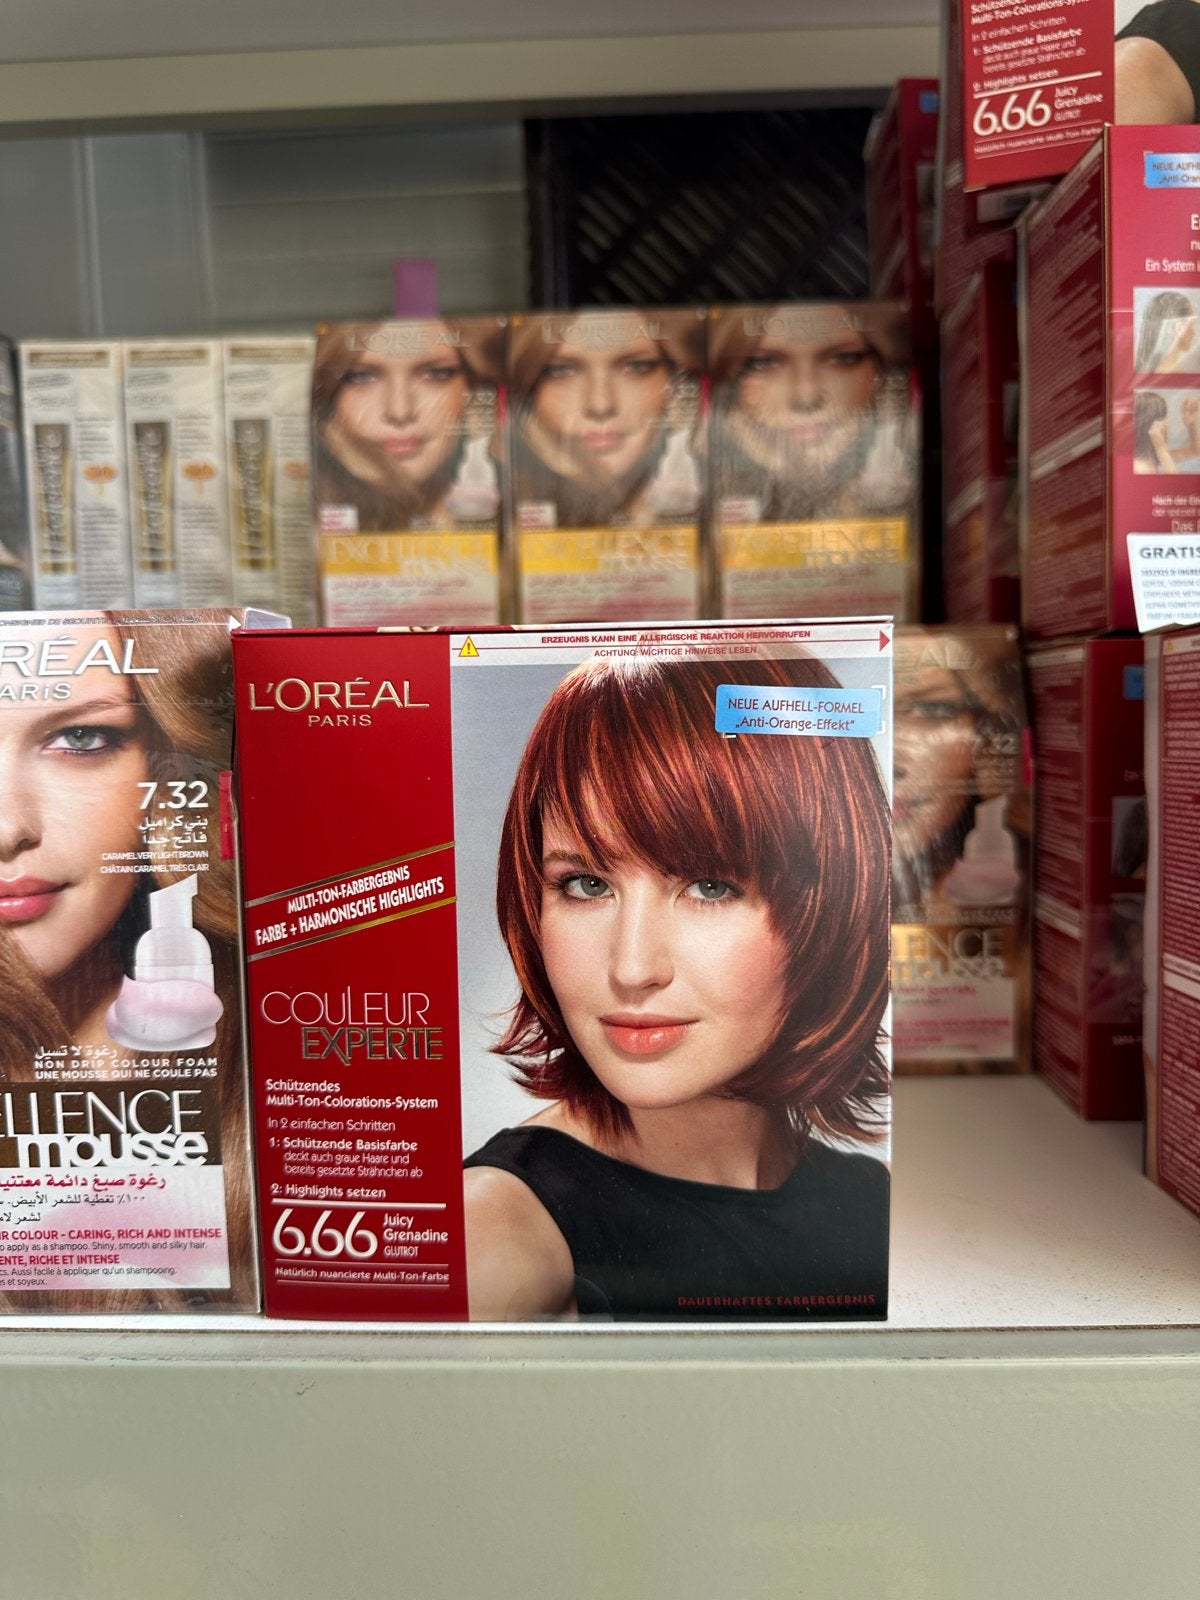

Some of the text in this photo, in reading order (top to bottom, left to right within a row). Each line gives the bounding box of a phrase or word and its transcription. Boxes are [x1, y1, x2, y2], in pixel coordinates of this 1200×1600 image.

[973, 89, 1052, 136] 6.66
[1145, 257, 1196, 274] Ein System
[541, 631, 811, 644] ERZEUGNIS KANN EINE ALLERGISCHE REAKTION HERVORRUFEN
[0, 636, 159, 676] RÉAL
[594, 646, 757, 657] ACHTUNG: WICHTIGE HINWEISE LESEN
[249, 677, 430, 712] L'ORÉAL
[728, 698, 864, 715] NEUE AUFHELL-FORMEL
[137, 780, 209, 810] 7.32
[139, 815, 208, 831] بني كراميل
[173, 831, 208, 848] فاتح
[102, 850, 209, 860] CARAMEL VERY LIGHT BROWN
[101, 863, 209, 873] CHÂTAIN CARAMEL TRÈS CLAIR
[287, 865, 411, 914] MULTI-TON-FARBERGEBNIS
[255, 876, 445, 945] FARBE + HARMONISCHE HIGHLIGHTS
[261, 986, 430, 1026] COULEUR
[35, 1045, 118, 1060] رغوة لا تسيل
[302, 1027, 443, 1066] EXPERTE
[34, 1057, 218, 1069] NON DRIP COLOUR FOAM
[36, 1068, 218, 1080] UNE MOUSSE QUI NE COULE PAS
[266, 1078, 341, 1093] Schützendes
[266, 1095, 439, 1110] Multi-Ton-Colorations-System
[0, 1089, 204, 1137] LLENCE
[268, 1118, 396, 1131] In 2 einfachen Schritten
[17, 1133, 209, 1168] mousse
[269, 1137, 418, 1151] 1: Schützende Basisfarbe
[284, 1151, 410, 1164] deckt auch graue Haare und
[284, 1164, 423, 1177] bereits gesetzte Strähnchen ab
[46, 1173, 88, 1187] دائمة
[93, 1174, 125, 1191] صبغ
[129, 1173, 167, 1189] رغوة
[271, 1183, 386, 1197] 2: Highlights setzen
[383, 1213, 414, 1228] Juicy
[12, 1230, 58, 1240] COLOUR
[69, 1229, 115, 1240] CARING,
[118, 1229, 144, 1239] RICH
[147, 1229, 171, 1239] AND
[174, 1228, 222, 1238] INTENSE
[272, 1208, 378, 1258] 6.66
[383, 1229, 449, 1241] Grenadine
[7, 1243, 29, 1252] apply
[50, 1243, 90, 1252] shampoo.
[93, 1241, 117, 1251] Shiny,
[119, 1241, 150, 1249] smooth
[152, 1241, 167, 1249] and
[170, 1241, 188, 1251] silky
[190, 1241, 207, 1249] hair.
[384, 1246, 419, 1256] GLUTROT
[30, 1255, 60, 1264] RICHE
[62, 1255, 74, 1264] ET
[77, 1254, 120, 1264] INTENSE
[12, 1267, 32, 1275] Aussi
[34, 1267, 54, 1275] facile
[57, 1266, 61, 1275] à
[64, 1267, 100, 1277] appliquer
[127, 1266, 177, 1276] shampooing.
[276, 1267, 450, 1281] Natürlich nuancierte Multi-Ton-Farbe
[17, 1279, 47, 1288] soyeux.
[678, 1295, 876, 1306] DAUERHAFTES FARBERGEBNIS
